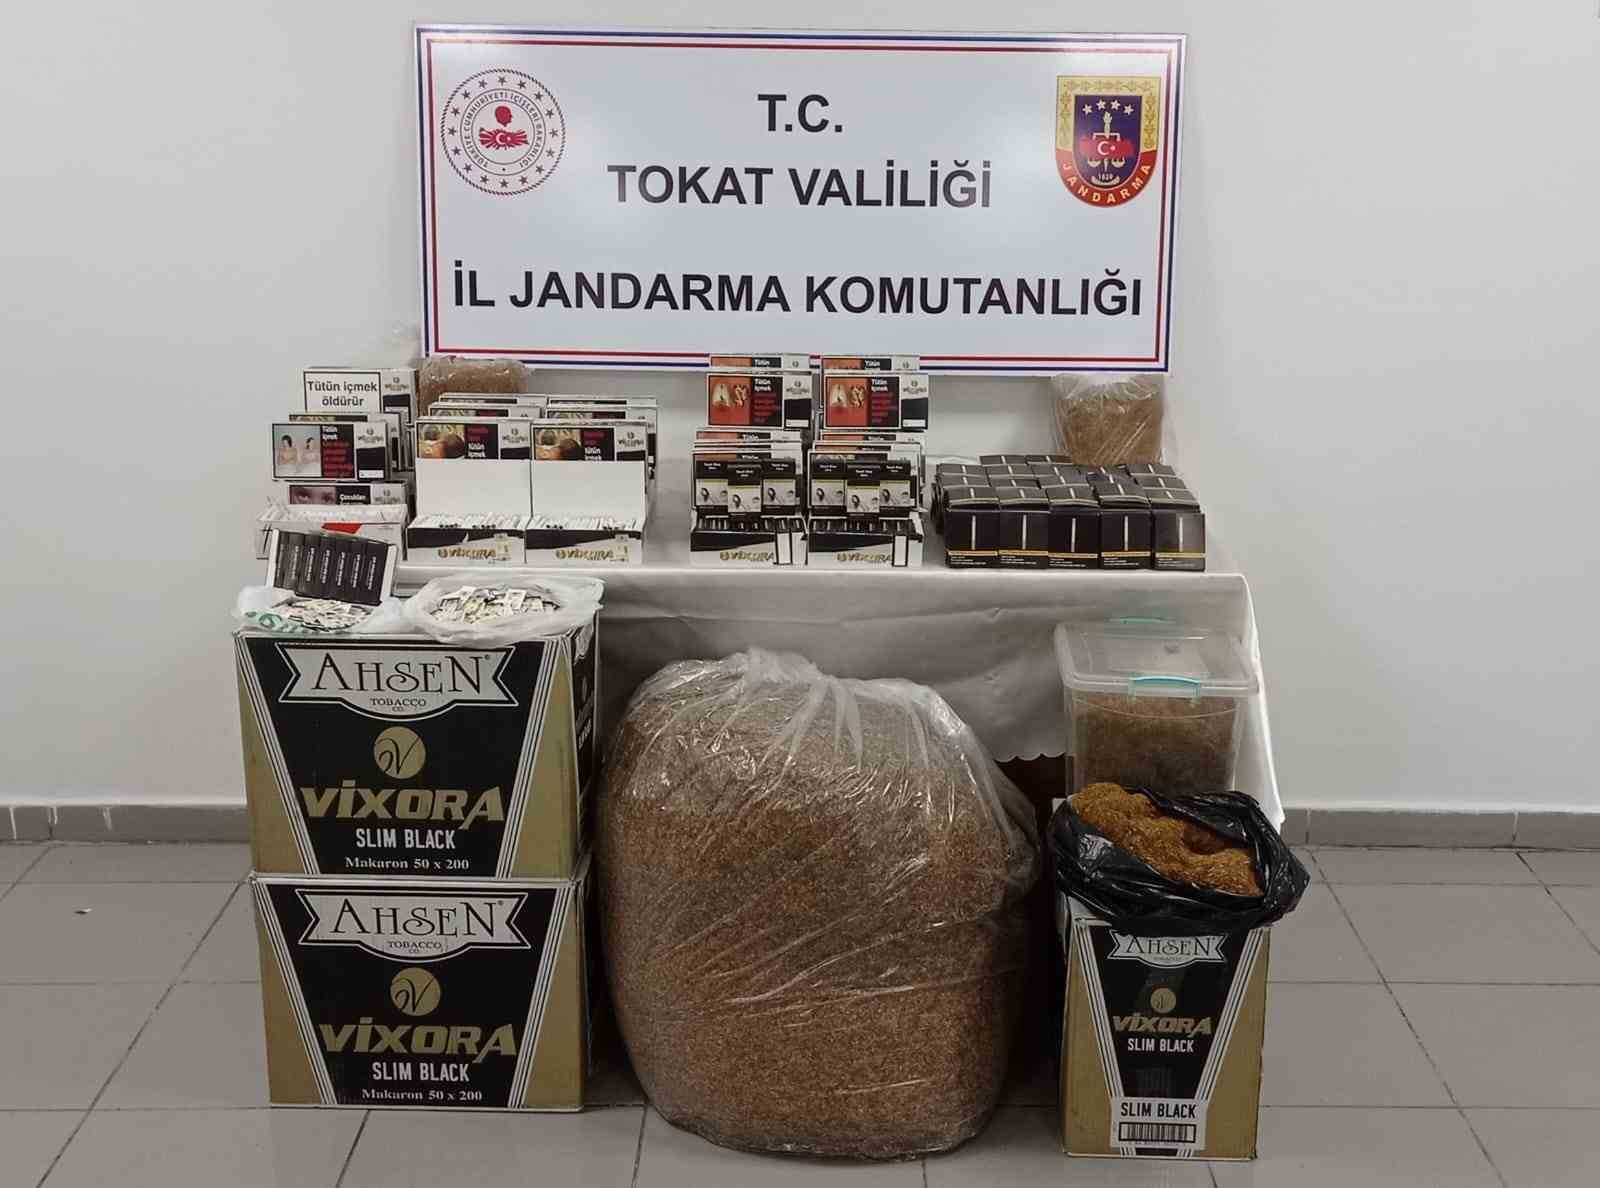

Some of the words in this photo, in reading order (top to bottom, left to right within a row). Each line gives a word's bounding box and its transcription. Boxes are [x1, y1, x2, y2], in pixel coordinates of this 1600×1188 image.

[758, 94, 844, 133] T.C.
[607, 165, 774, 206] TOKAT
[788, 159, 991, 208] VALİLİĞİ
[1062, 163, 1151, 204] JANDARMA
[454, 260, 502, 309] İL
[510, 270, 789, 313] JANDARMA
[806, 268, 1142, 316] KOMUTANLIĞI
[307, 381, 341, 392] Tütün
[343, 381, 377, 394] içmek
[321, 395, 365, 407] öldürür
[311, 652, 486, 696] AHSEN
[369, 698, 426, 706] TOBACCO
[300, 779, 505, 830] VİXORA
[356, 828, 397, 848] SLIM
[405, 828, 456, 849] BLACK
[345, 856, 408, 870] Makaron
[413, 857, 430, 870] 50
[434, 861, 442, 870] x
[445, 858, 470, 870] 200
[330, 898, 497, 937] AHSEN
[388, 941, 442, 949] TOBACCO
[1126, 936, 1210, 956] AHSEN
[1112, 1012, 1213, 1038] VİXORA
[319, 1017, 517, 1063] VİXORA
[1128, 1038, 1155, 1052] SLIM
[1160, 1039, 1194, 1053] BLACK
[373, 1063, 413, 1081] SLIM
[420, 1063, 470, 1082] BLACK
[362, 1088, 423, 1100] Makaron
[429, 1089, 444, 1100] 50
[447, 1091, 455, 1100] x
[459, 1090, 482, 1101] 200
[1120, 1102, 1152, 1117] SLIM
[1157, 1103, 1196, 1119] BLACK
